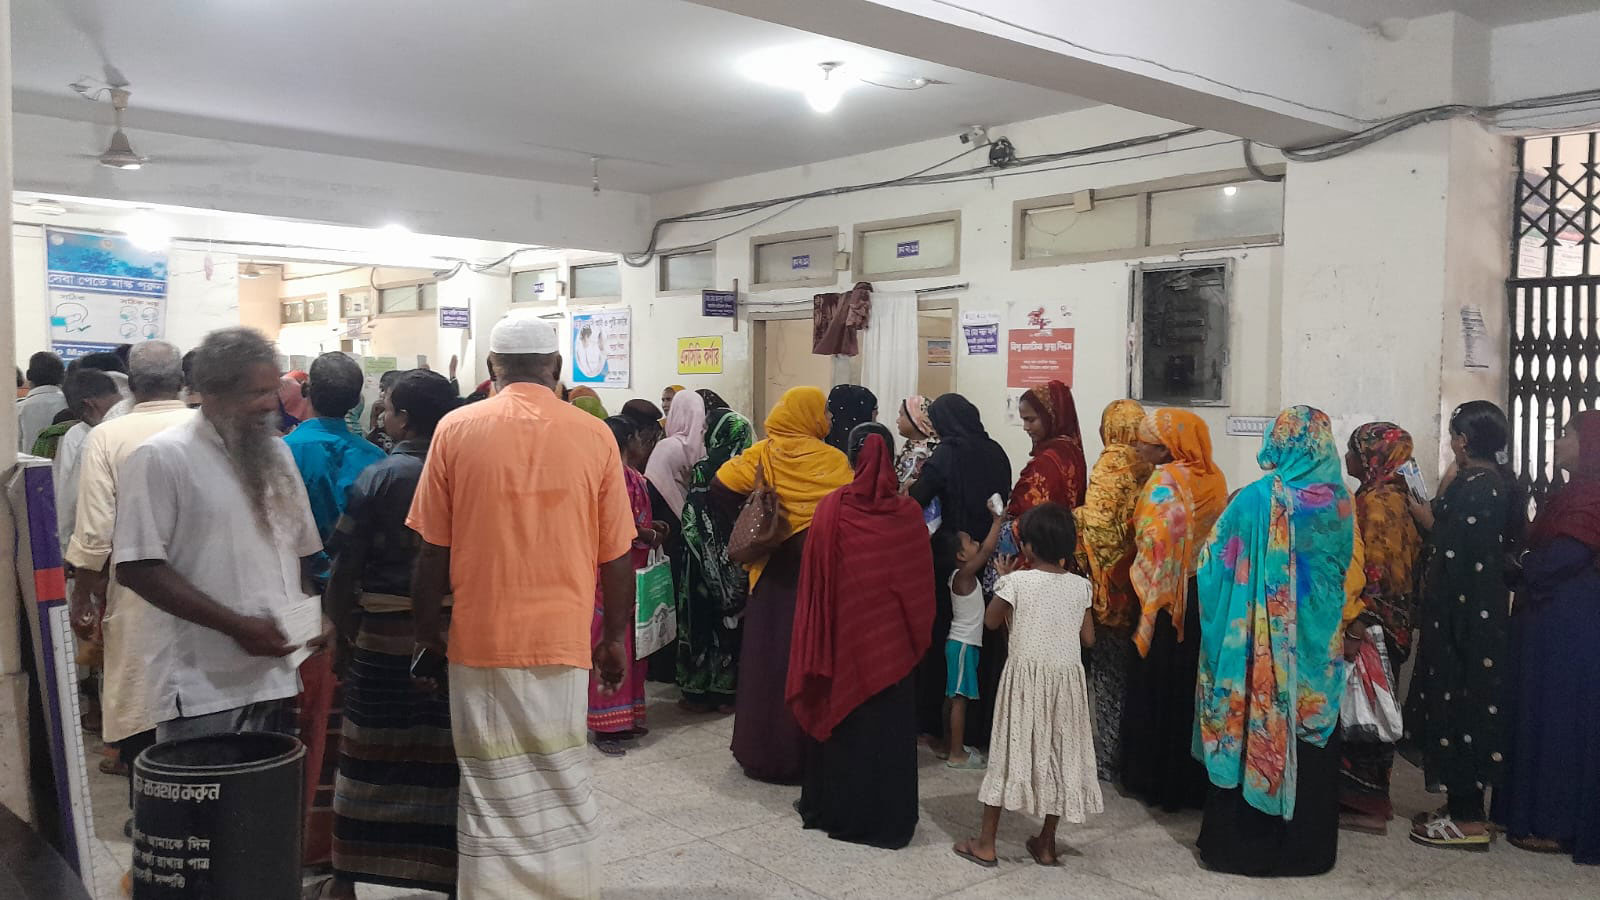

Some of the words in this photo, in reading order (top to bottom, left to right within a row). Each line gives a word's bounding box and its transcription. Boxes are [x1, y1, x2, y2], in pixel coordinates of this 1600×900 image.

[49, 273, 75, 285] সেবা
[79, 276, 108, 287] পেতে
[181, 783, 221, 804] করুন
[187, 836, 211, 851] দিন
